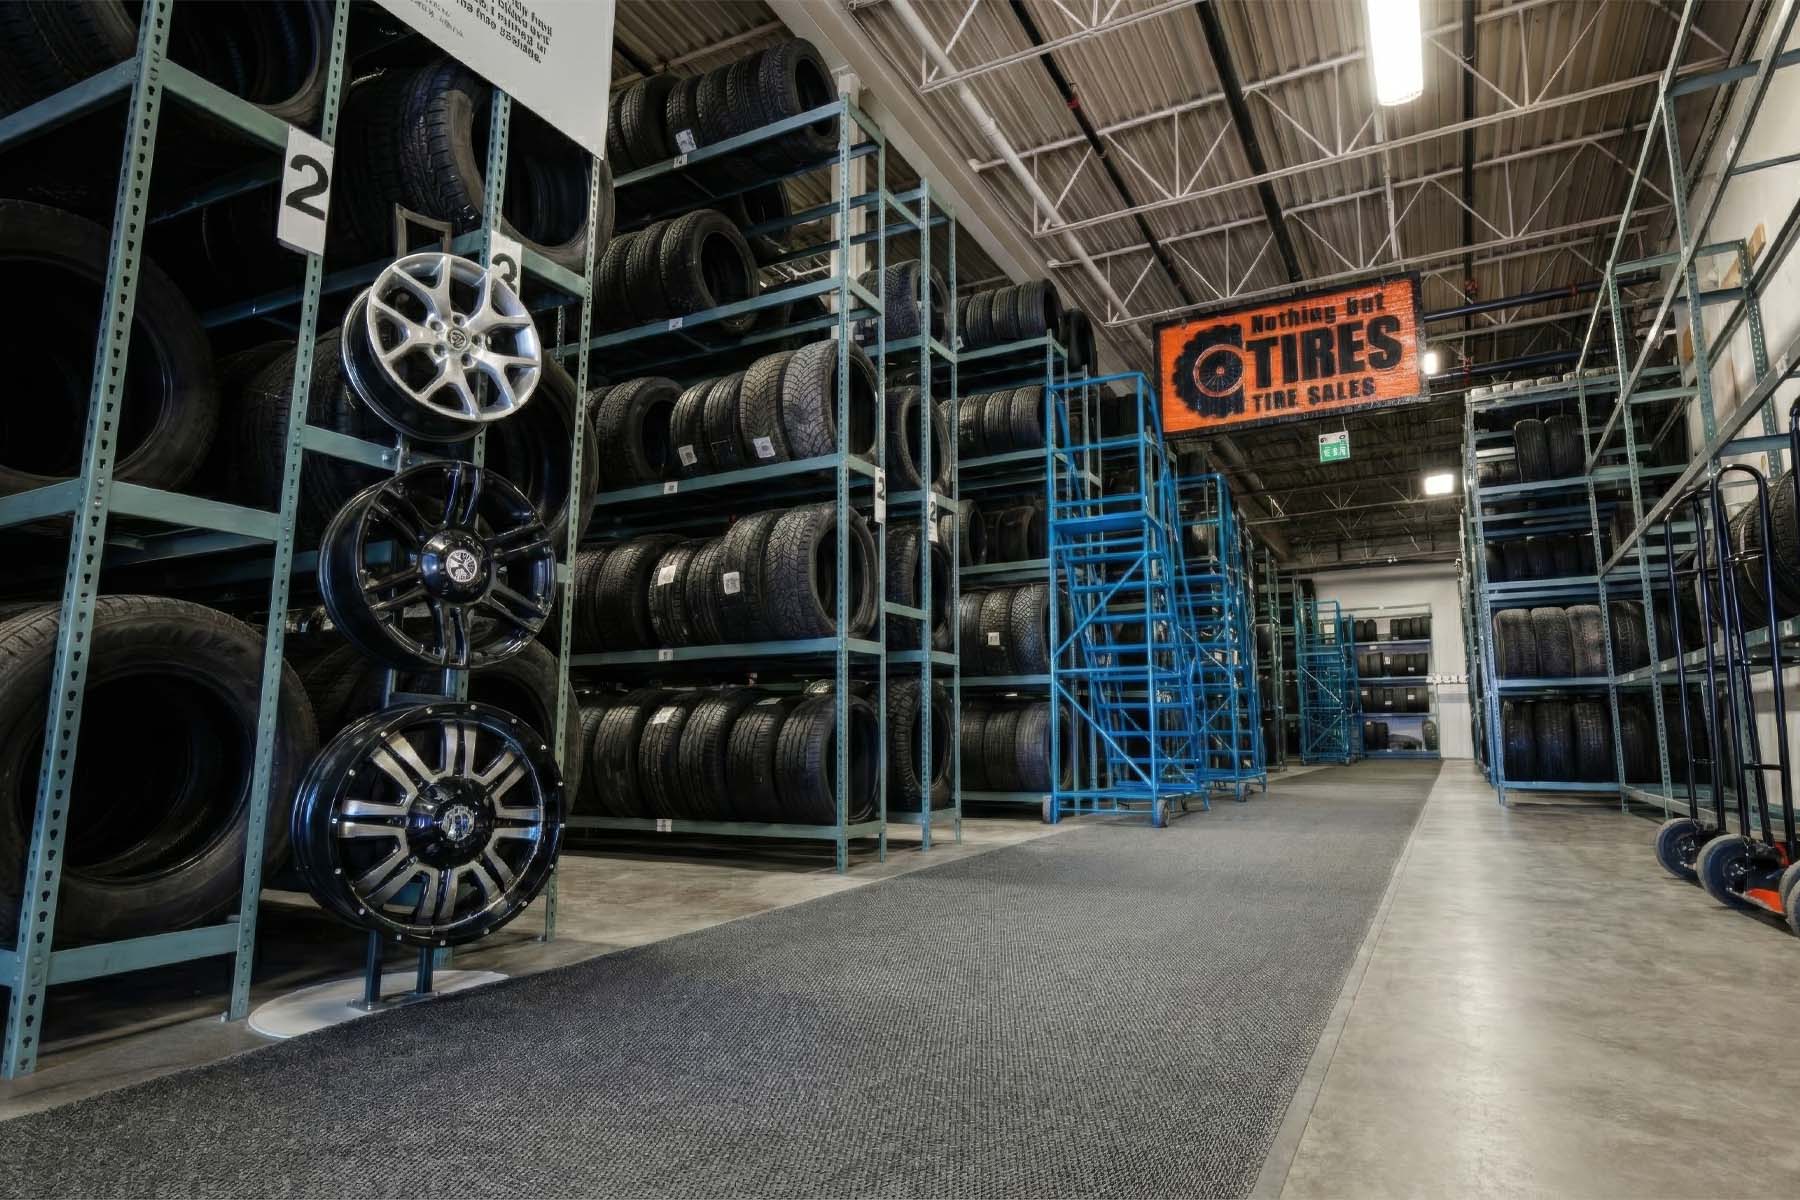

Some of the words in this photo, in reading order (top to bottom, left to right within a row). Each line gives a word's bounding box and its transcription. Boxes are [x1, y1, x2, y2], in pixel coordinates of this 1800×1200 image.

[285, 154, 329, 221] 2
[1251, 306, 1336, 334] Nothing
[1246, 315, 1402, 388] TIRES
[1252, 388, 1297, 412] TIRE
[1307, 376, 1376, 406] SALES
[877, 477, 884, 501] 2
[930, 501, 936, 522] 2
